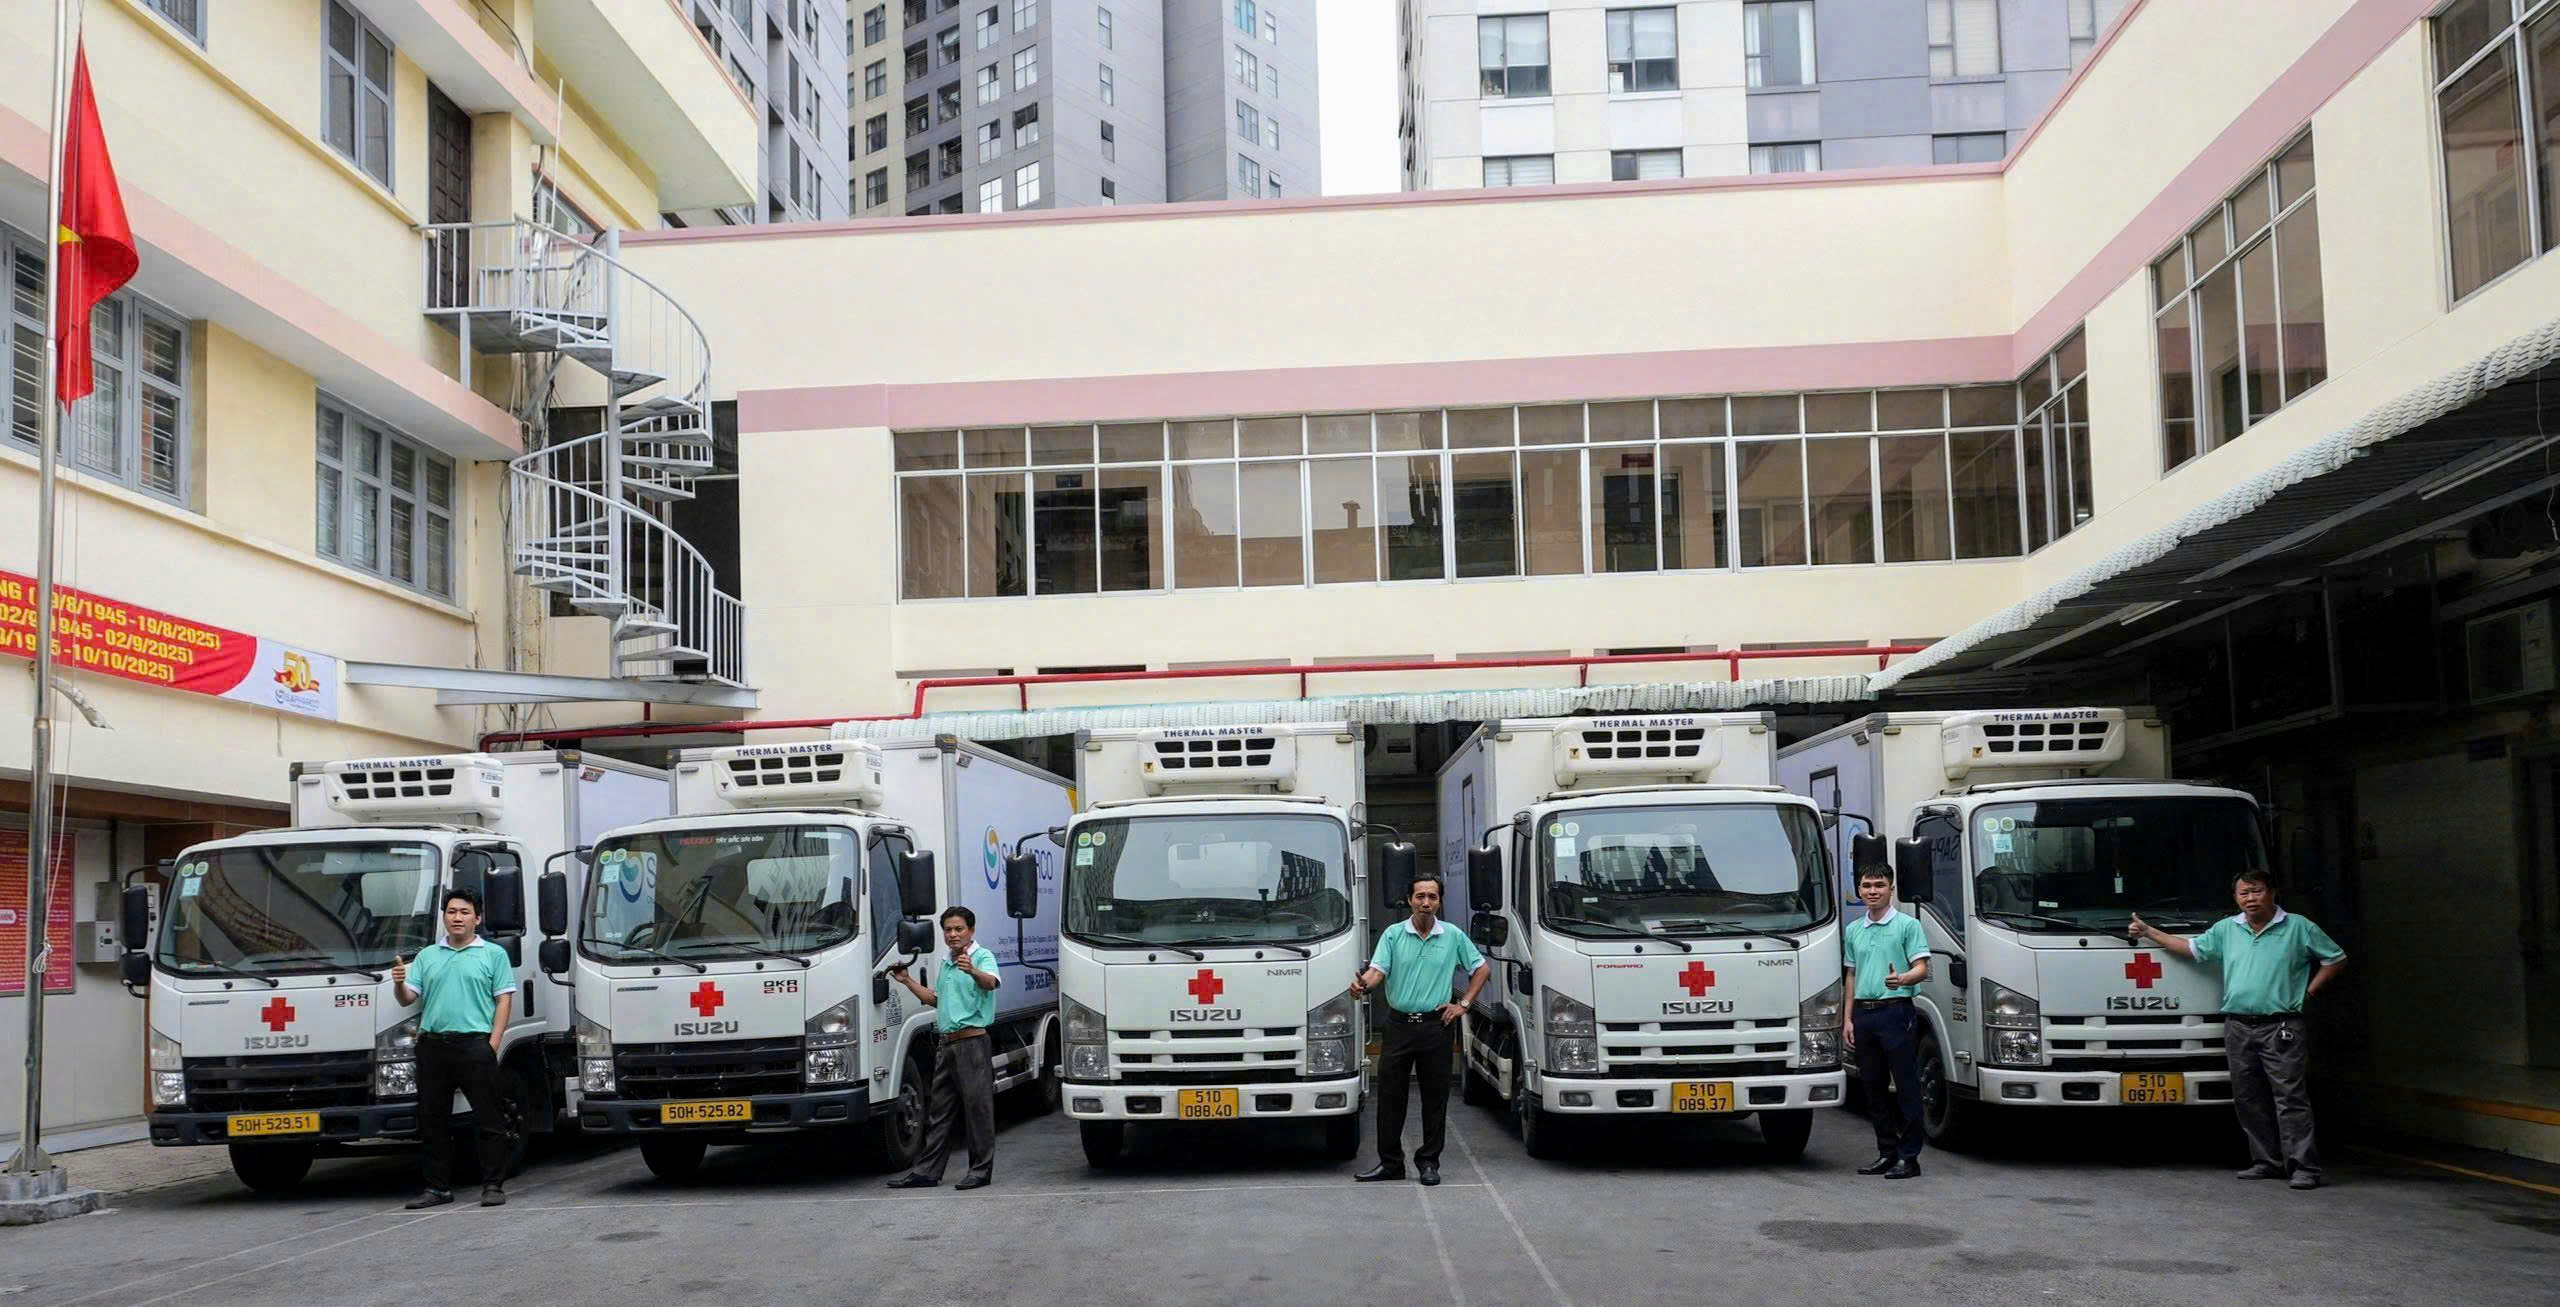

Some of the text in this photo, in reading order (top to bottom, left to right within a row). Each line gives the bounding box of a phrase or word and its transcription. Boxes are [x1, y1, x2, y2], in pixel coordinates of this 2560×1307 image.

[28, 586, 127, 626] (9/8/1945
[0, 603, 93, 640] 02/91945
[1649, 718, 1694, 726] MASTER
[1994, 711, 2098, 722] THERMAL MASTER
[1163, 727, 1263, 737] THERMAL MASTER
[736, 744, 833, 757] THERMAL MASTER
[346, 759, 443, 770] THERMAL MASTER
[1758, 959, 1794, 967] NMR
[1267, 968, 1303, 976] NMR
[763, 986, 798, 994] 210
[334, 1000, 369, 1008] 210
[1662, 1000, 1734, 1015] ISUZU
[2106, 996, 2180, 1010] ISUZU
[1170, 1008, 1242, 1022] ISUZU
[674, 1020, 739, 1036] ISUZU
[244, 1034, 310, 1050] ISUZU
[2138, 1075, 2166, 1088] 51D
[1195, 1090, 1221, 1103] 51D
[1689, 1084, 1716, 1097] 51D
[2128, 1089, 2177, 1102] 087.13
[1679, 1097, 1727, 1111] 089.37
[668, 1104, 745, 1120] 50H-525.82
[1185, 1104, 1232, 1118] 088.40
[235, 1115, 312, 1132] 50H-529.51
